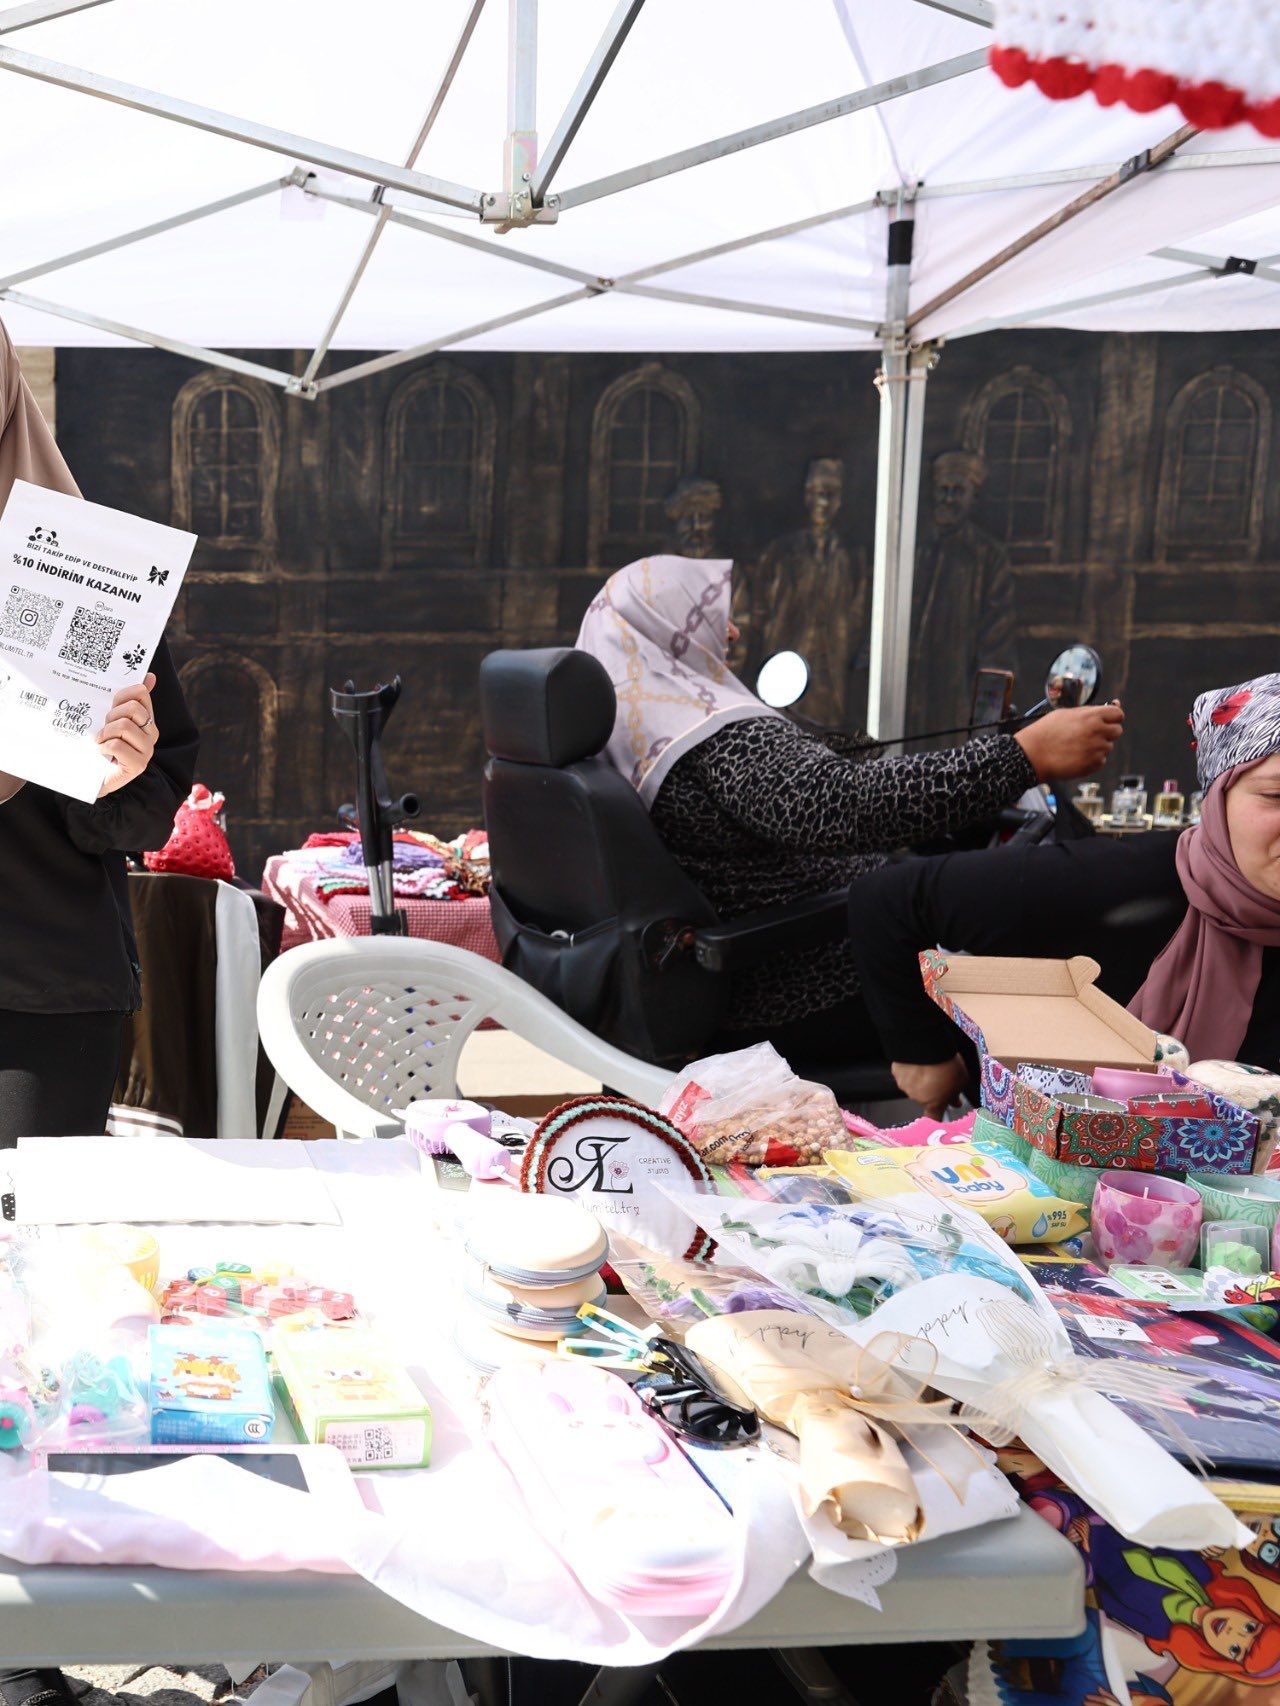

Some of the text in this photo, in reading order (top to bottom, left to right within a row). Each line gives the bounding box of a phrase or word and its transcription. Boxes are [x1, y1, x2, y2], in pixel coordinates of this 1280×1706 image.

[26, 542, 138, 583] BİZİ TAKİP EDİP VE DESTEKLEYİP
[13, 553, 142, 604] %10 İNDİRİM KAZANIN
[20, 690, 48, 706] LIMITED
[58, 699, 89, 717] Create
[65, 711, 82, 724] gift
[52, 717, 92, 736] cherish
[638, 1157, 672, 1165] CREATIVE
[952, 1180, 1006, 1194] baby
[203, 1288, 220, 1297] 8
